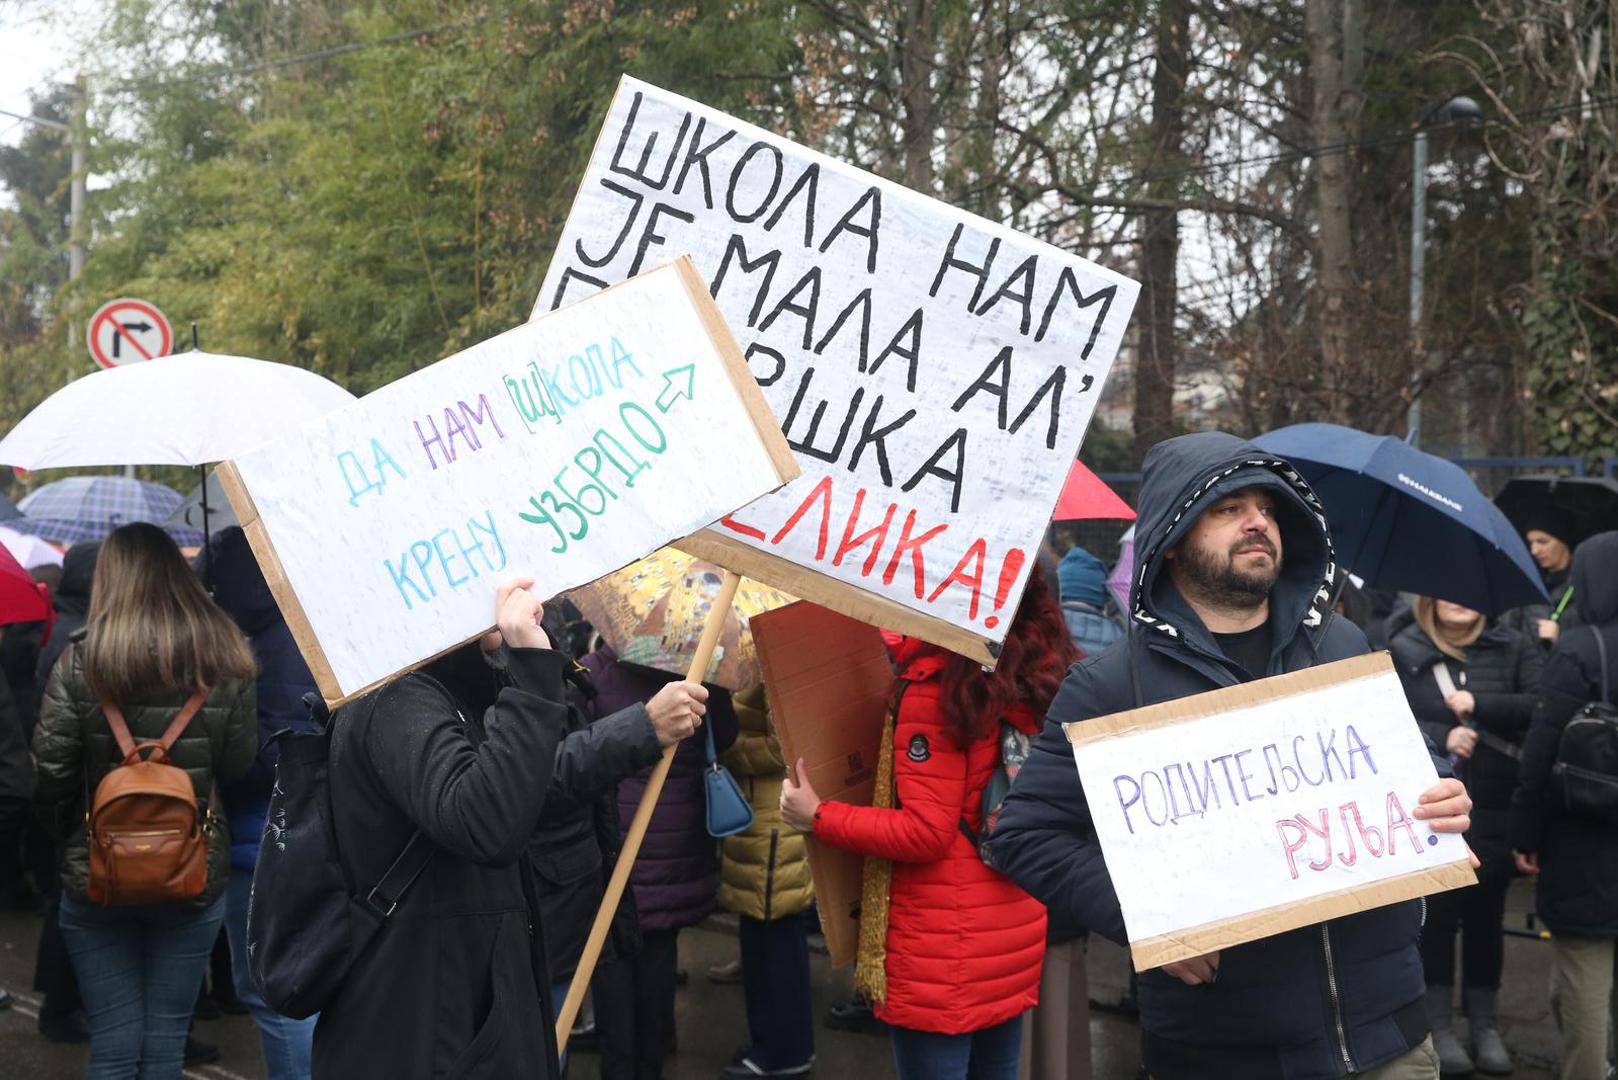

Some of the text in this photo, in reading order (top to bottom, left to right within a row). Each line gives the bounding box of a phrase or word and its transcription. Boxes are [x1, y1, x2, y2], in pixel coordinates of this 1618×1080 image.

[610, 91, 1118, 360] ШКОЛА НАМ
[711, 234, 924, 393] МАЛА
[337, 437, 408, 508] ДА
[412, 393, 505, 470] НАМ
[384, 509, 509, 610] КРЕНУ
[518, 401, 668, 554] УЗБРДО
[720, 475, 1027, 629] ЛИКА!
[1113, 724, 1378, 834] РОДИТЕЉСКА
